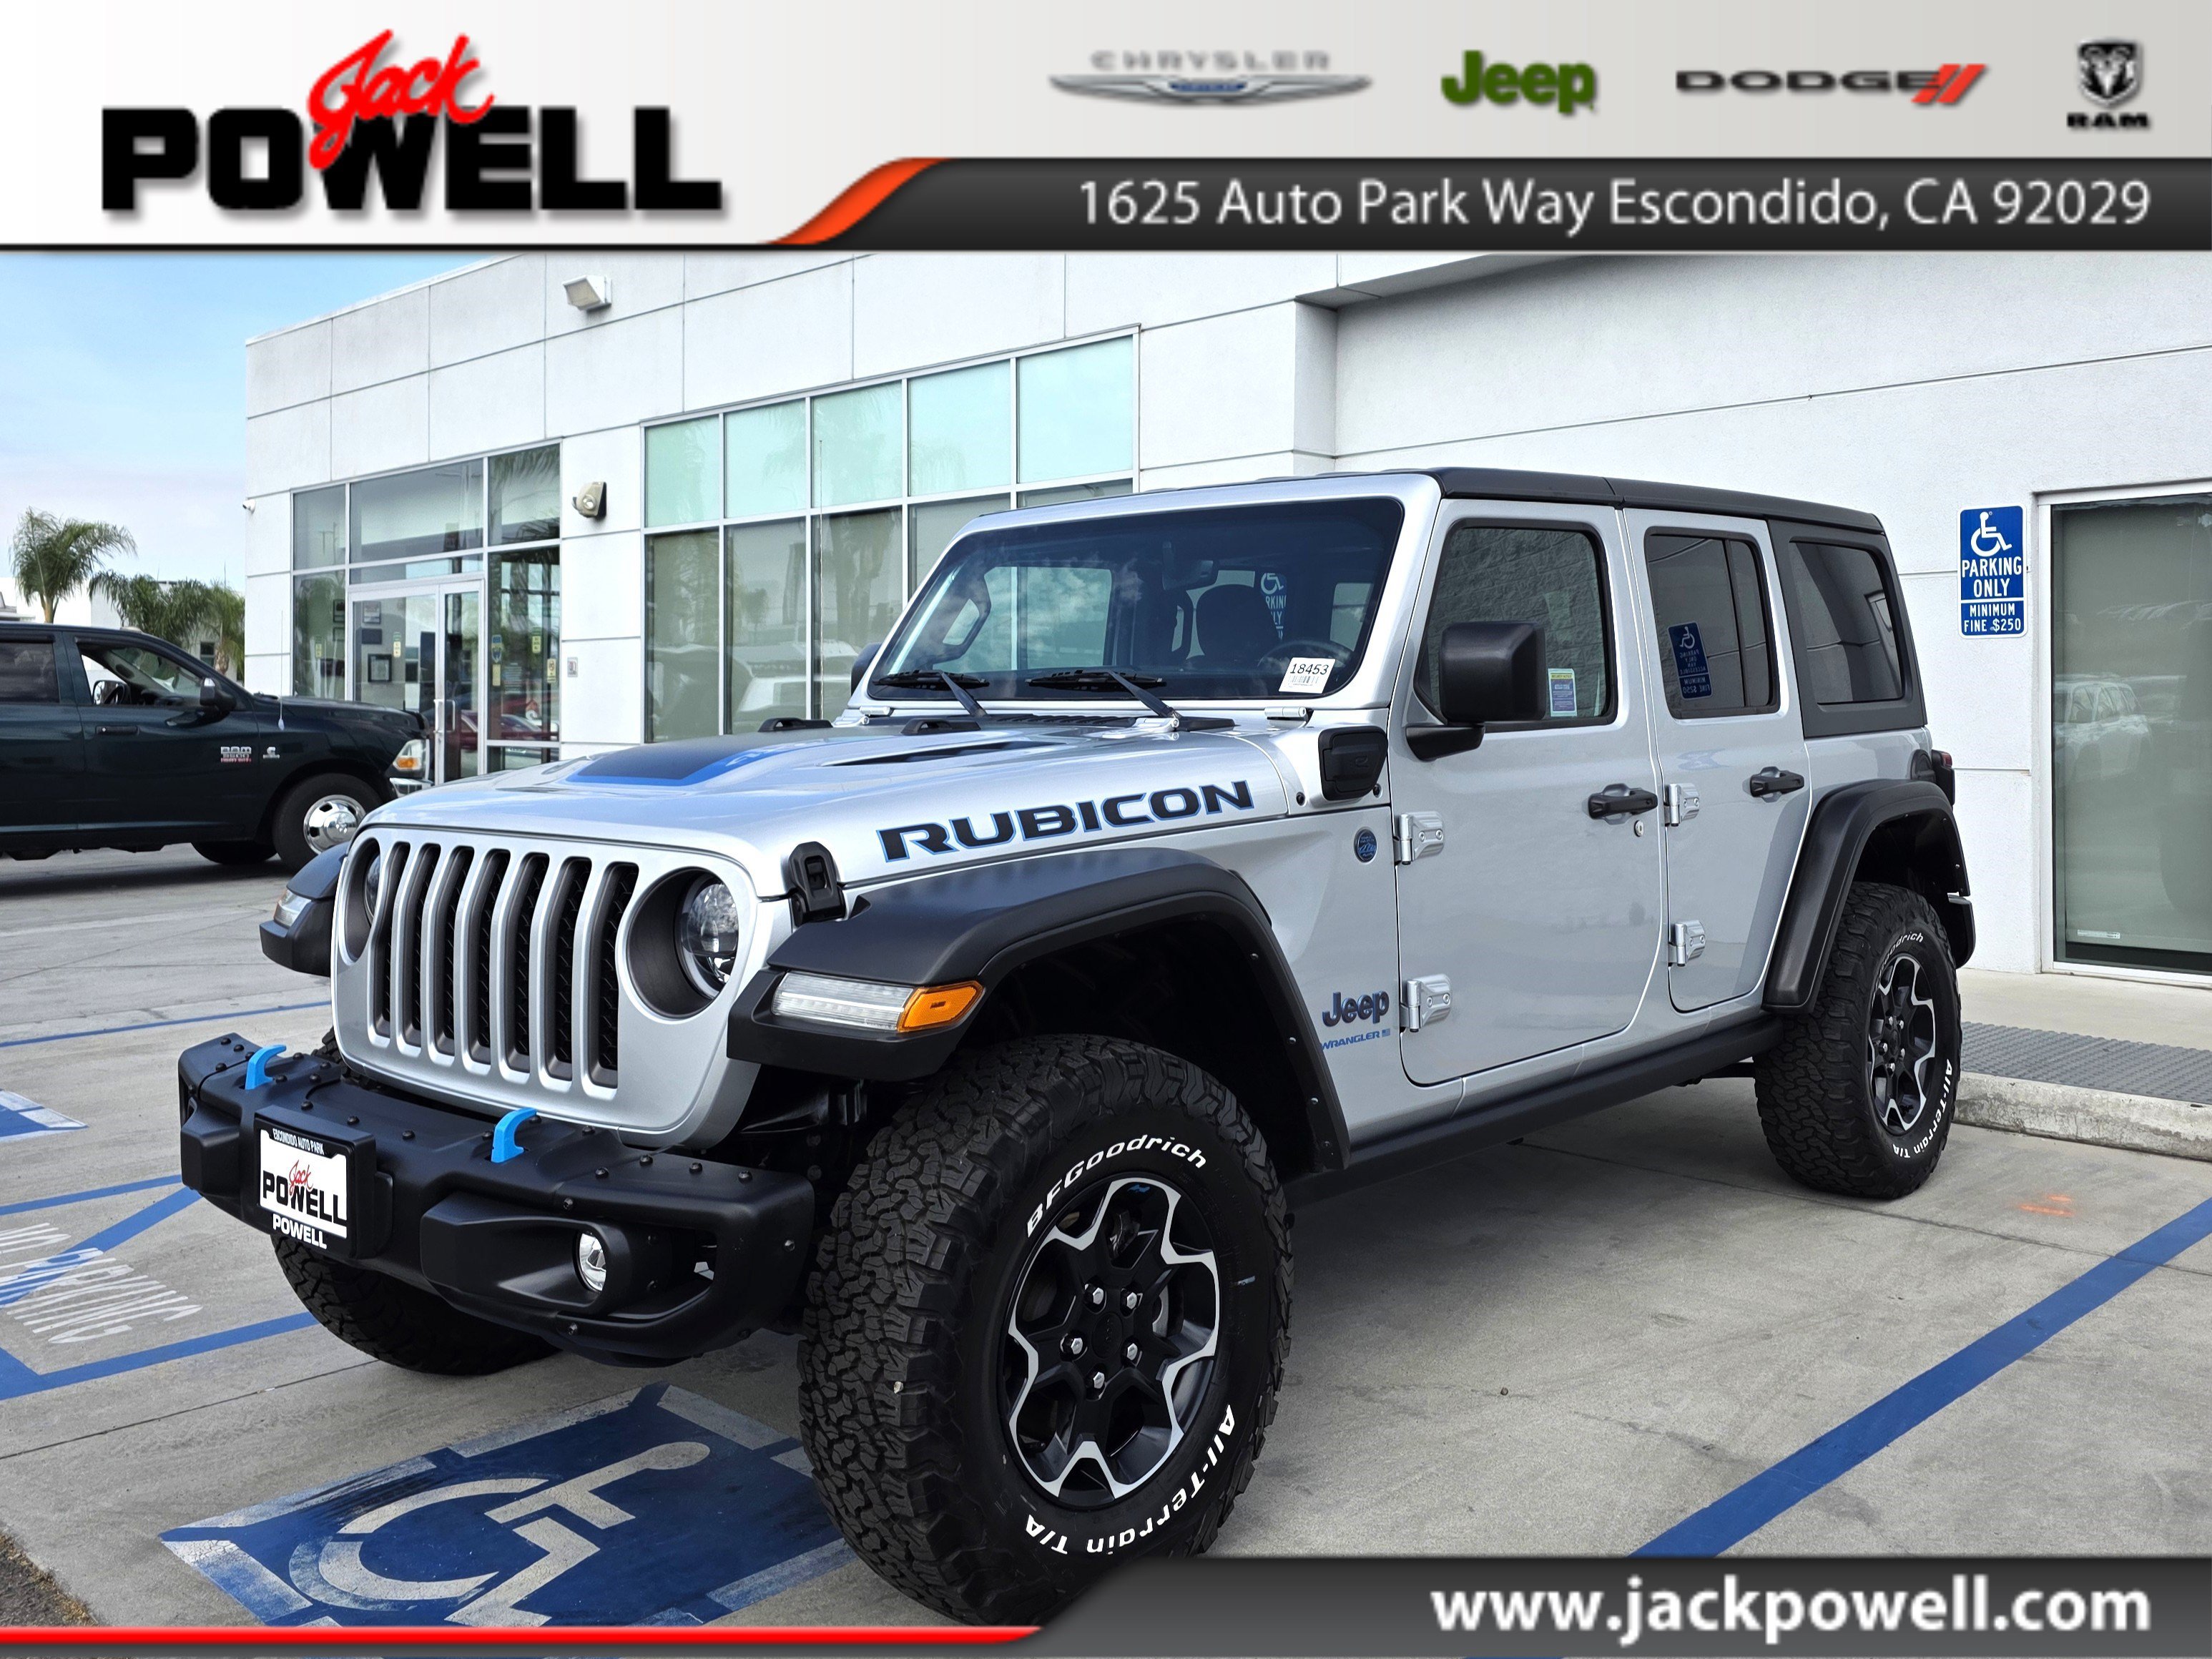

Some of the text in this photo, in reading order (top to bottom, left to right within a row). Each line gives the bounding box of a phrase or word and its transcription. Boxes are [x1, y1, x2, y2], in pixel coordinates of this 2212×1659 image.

[1962, 556, 2022, 578] PARKING
[1973, 578, 2010, 598] ONLY
[1964, 618, 2022, 633] FINE $250
[1970, 603, 2015, 617] MINIMUM
[1289, 663, 1329, 675] 18453
[875, 779, 1255, 863] RUBICON
[1322, 990, 1390, 1028] Jeep
[1321, 1030, 1380, 1050] WRANGLER
[1913, 1058, 1952, 1154] All-Terrain
[272, 1128, 325, 1156] ESCONDIDO AUTO PARK
[289, 1159, 313, 1196] Jack
[1027, 1134, 1206, 1238] BFGoodrich
[262, 1170, 348, 1227] POWELL
[272, 1214, 327, 1250] POWELL
[1026, 1404, 1235, 1555] All-Terrain T/A
